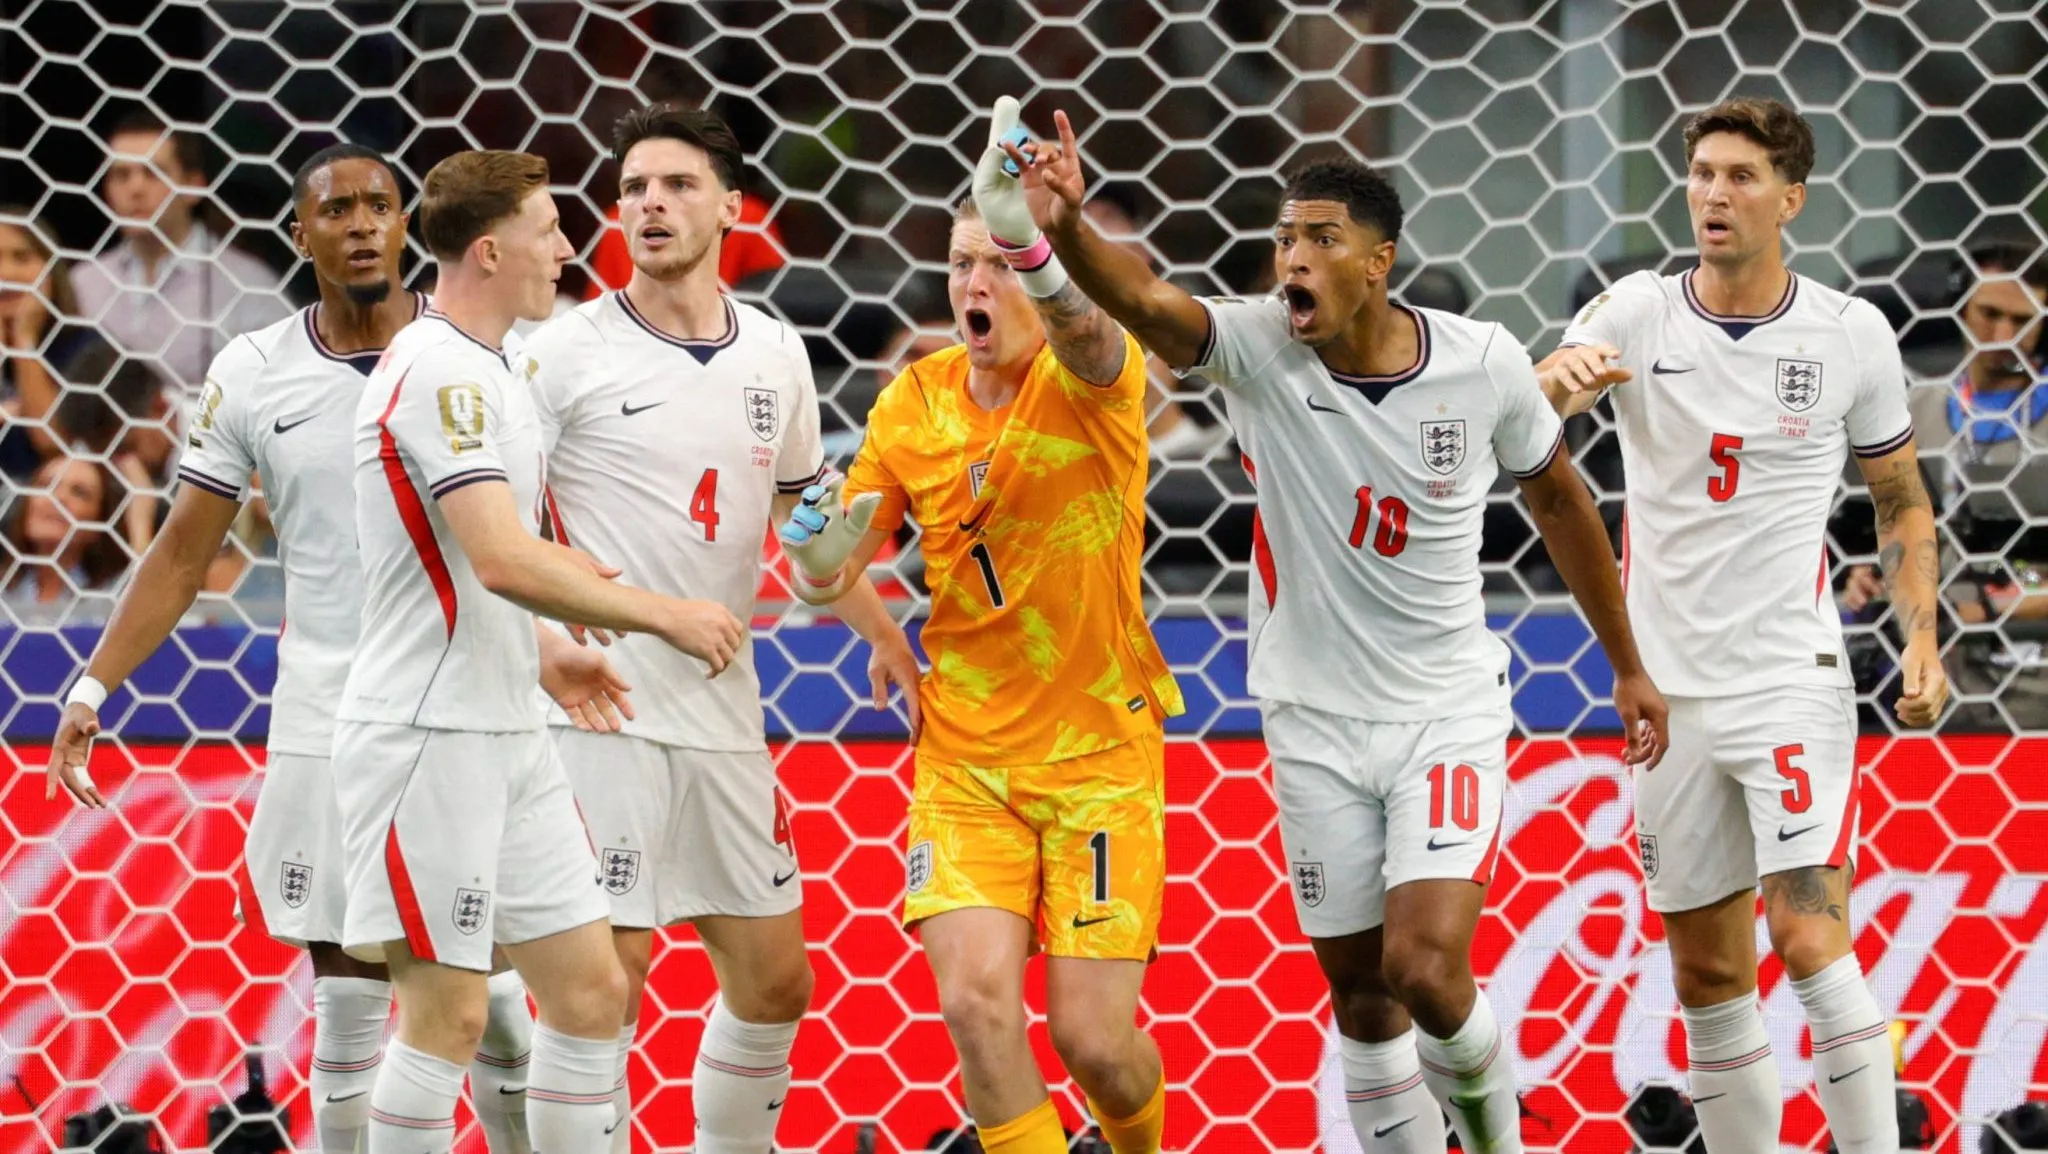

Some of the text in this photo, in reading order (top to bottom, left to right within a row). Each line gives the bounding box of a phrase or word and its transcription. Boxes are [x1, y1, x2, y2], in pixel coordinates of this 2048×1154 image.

[1777, 415, 1810, 426] CROATIA
[1427, 479, 1457, 489] CROATIA
[1707, 432, 1743, 502] 5
[690, 468, 719, 541] 4
[1348, 485, 1409, 557] 10
[969, 543, 1005, 609] 1
[1427, 763, 1479, 832] 10
[1773, 743, 1812, 814] 5
[773, 785, 793, 857] 4
[1089, 831, 1108, 904] 1
